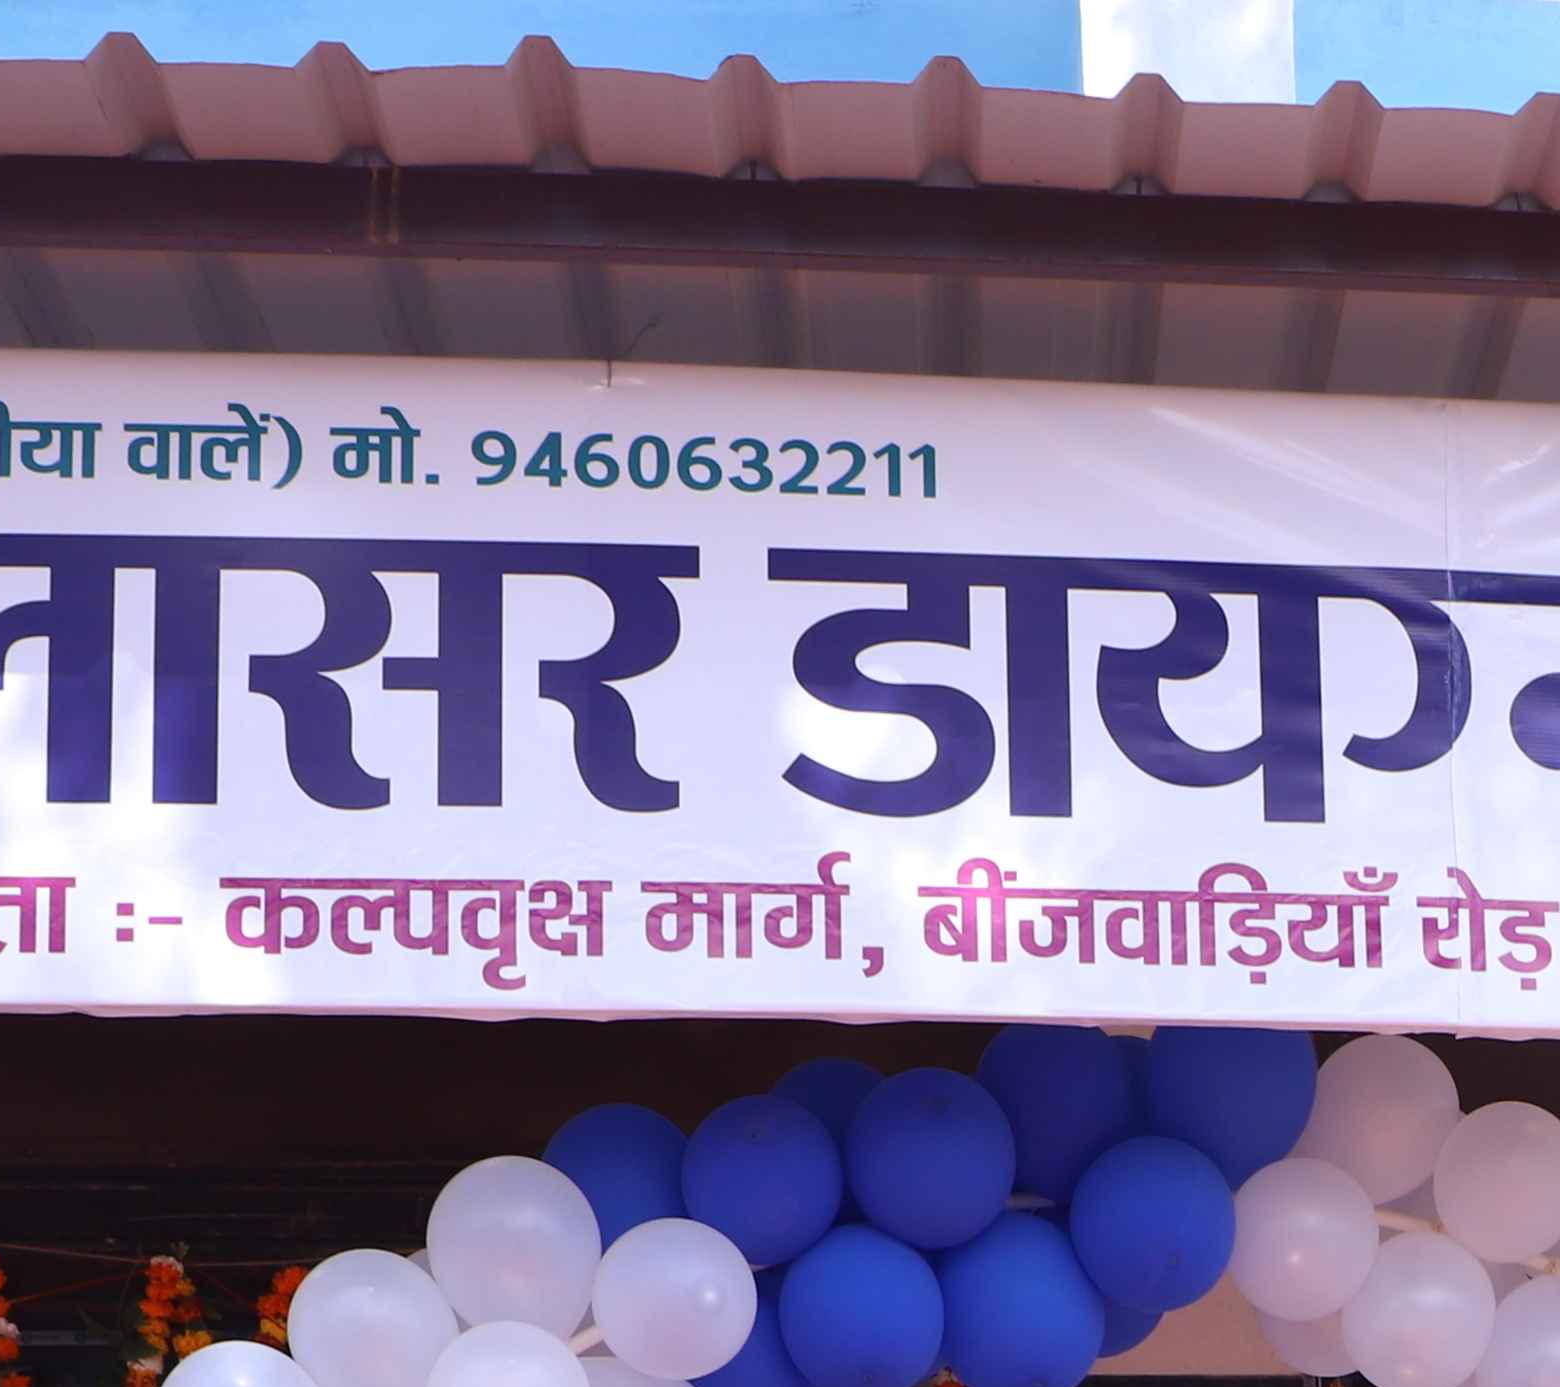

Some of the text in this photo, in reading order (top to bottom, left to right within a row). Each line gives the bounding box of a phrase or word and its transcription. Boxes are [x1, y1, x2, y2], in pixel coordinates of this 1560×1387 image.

[330, 406, 441, 486] मो.
[471, 429, 939, 498] 9460632211
[220, 877, 612, 991] कल्पवृक्ष
[639, 851, 885, 979] मार्ग,
